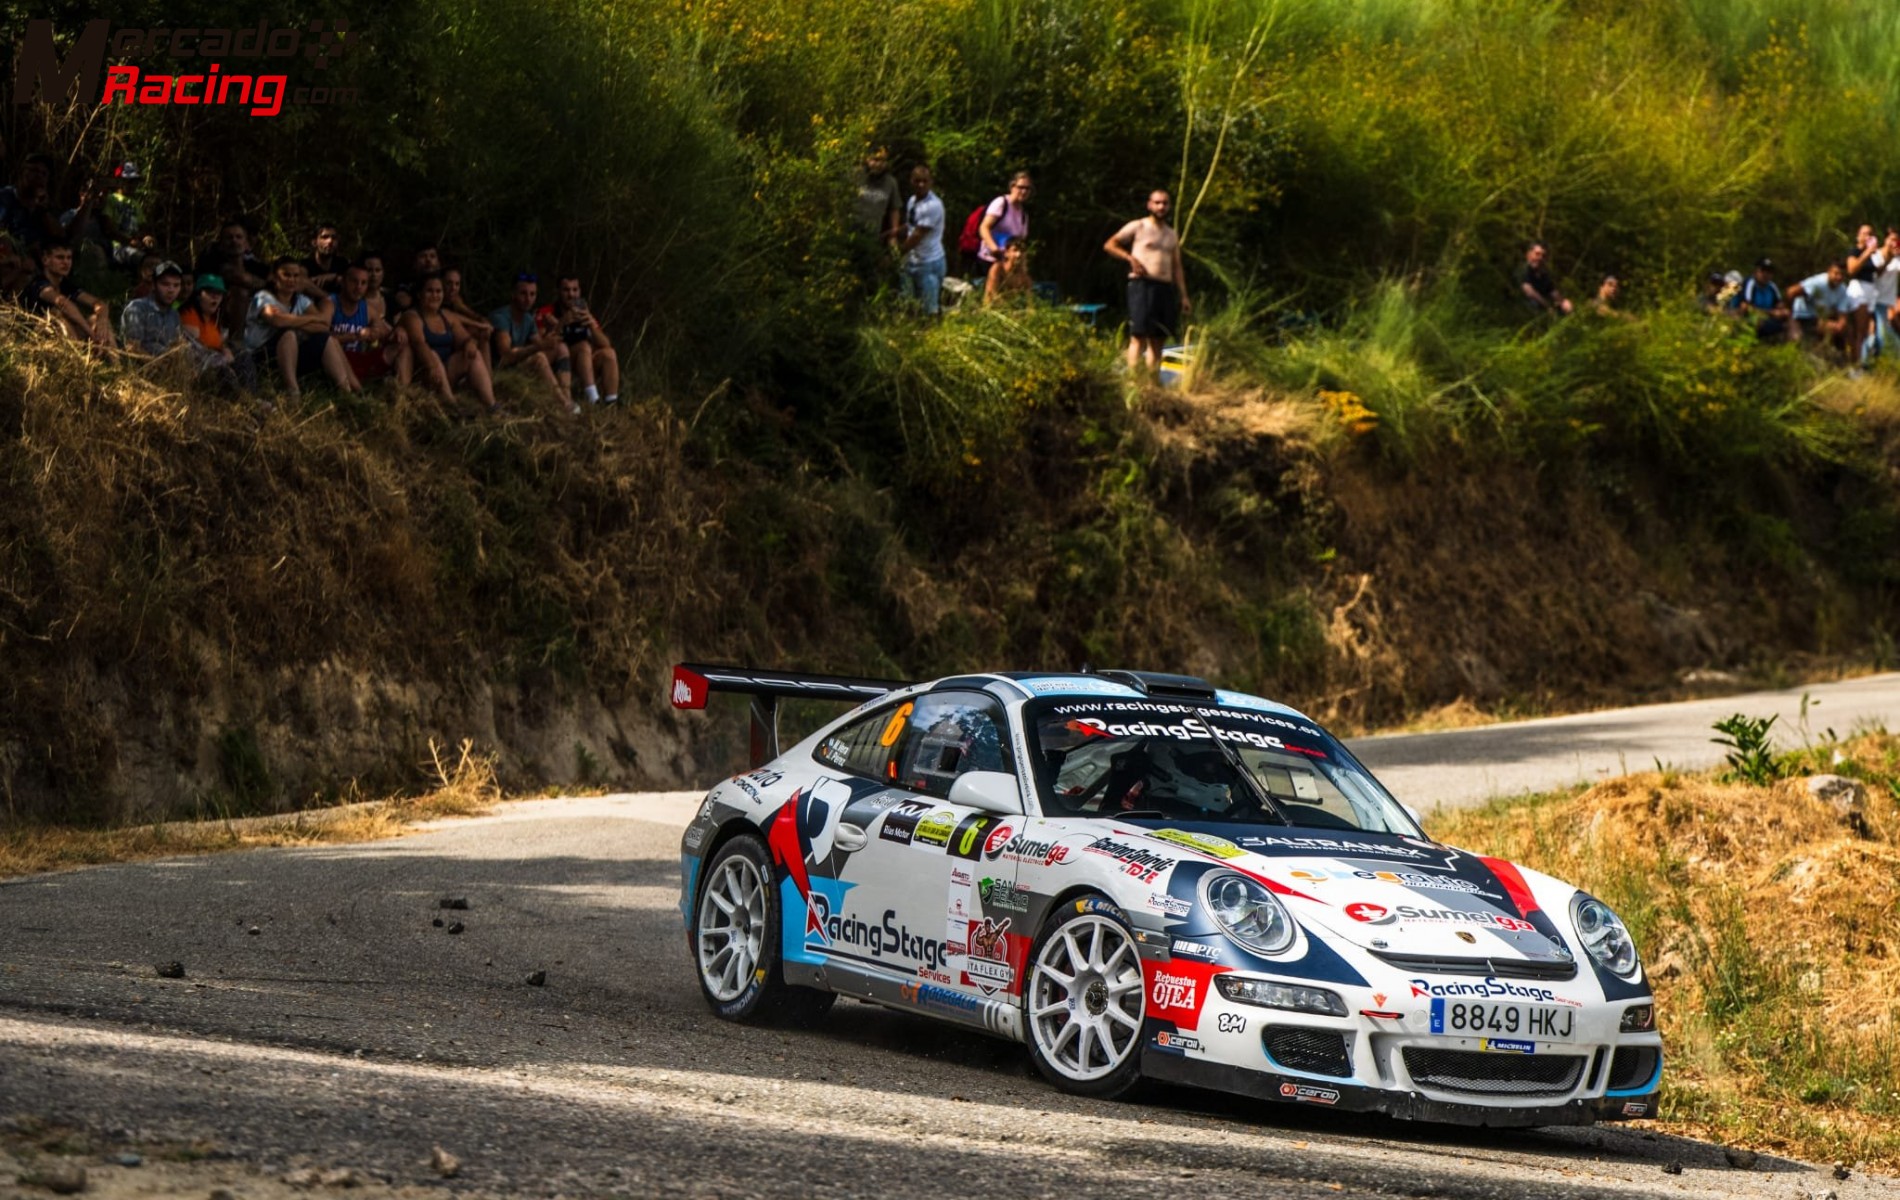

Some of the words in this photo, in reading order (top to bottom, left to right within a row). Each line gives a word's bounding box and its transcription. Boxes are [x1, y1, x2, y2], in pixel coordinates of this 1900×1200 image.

[881, 702, 914, 747] 6
[1072, 718, 1284, 748] RacingStage
[894, 826, 911, 839] Motor
[959, 817, 988, 855] 6
[1006, 833, 1070, 867] Sumelga
[1396, 905, 1536, 932] Sumelga
[918, 965, 951, 985] Services
[1154, 970, 1197, 988] Repuestos
[1152, 982, 1196, 1009] OJEA
[1408, 976, 1555, 1001] RacingStage
[1434, 1019, 1441, 1028] E
[1451, 1003, 1520, 1033] 8849
[1528, 1007, 1573, 1037] HKJ
[1170, 1036, 1198, 1050] ceroil
[1497, 1042, 1532, 1052] MICHELIN
[1297, 1086, 1337, 1100] ceroil
